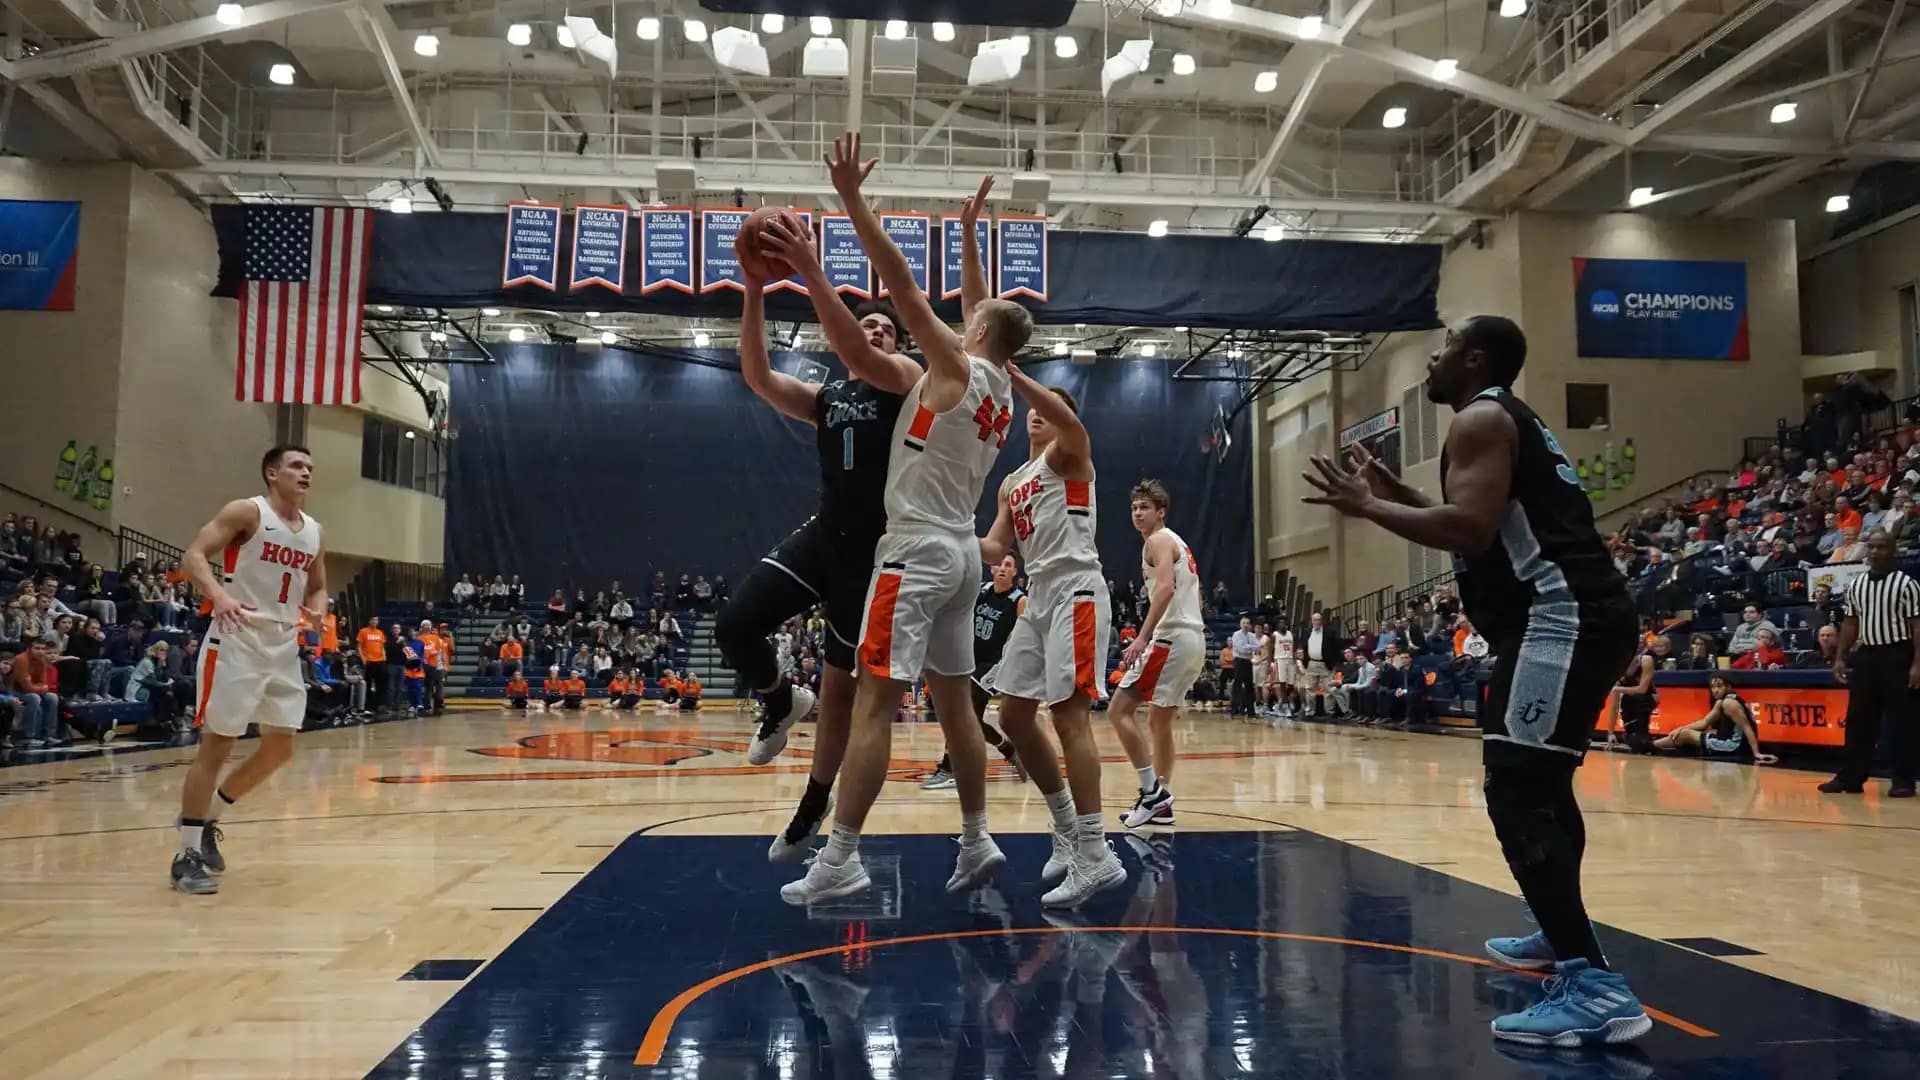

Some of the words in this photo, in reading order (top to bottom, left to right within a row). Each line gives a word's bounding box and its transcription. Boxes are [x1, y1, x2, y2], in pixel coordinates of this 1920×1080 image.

[521, 210, 548, 219] NCAA
[586, 212, 616, 221] NCAA
[652, 214, 682, 222] NCAA
[712, 215, 742, 223] NCAA
[582, 220, 611, 228] DIVISION
[890, 220, 920, 228] NCAA
[514, 235, 551, 243] CHAMPIONS
[584, 231, 616, 239] NATIONAL
[580, 238, 619, 246] CHAMPIONS
[512, 253, 550, 261] BASKETBALL
[578, 256, 617, 264] BASKETBALL
[1624, 293, 1735, 311] CHAMPIONS
[1626, 310, 1650, 318] PLAY
[843, 427, 854, 470] 1
[1008, 474, 1044, 507] OPE
[1014, 503, 1035, 542] 51
[278, 572, 292, 604] 1
[975, 616, 994, 640] 20
